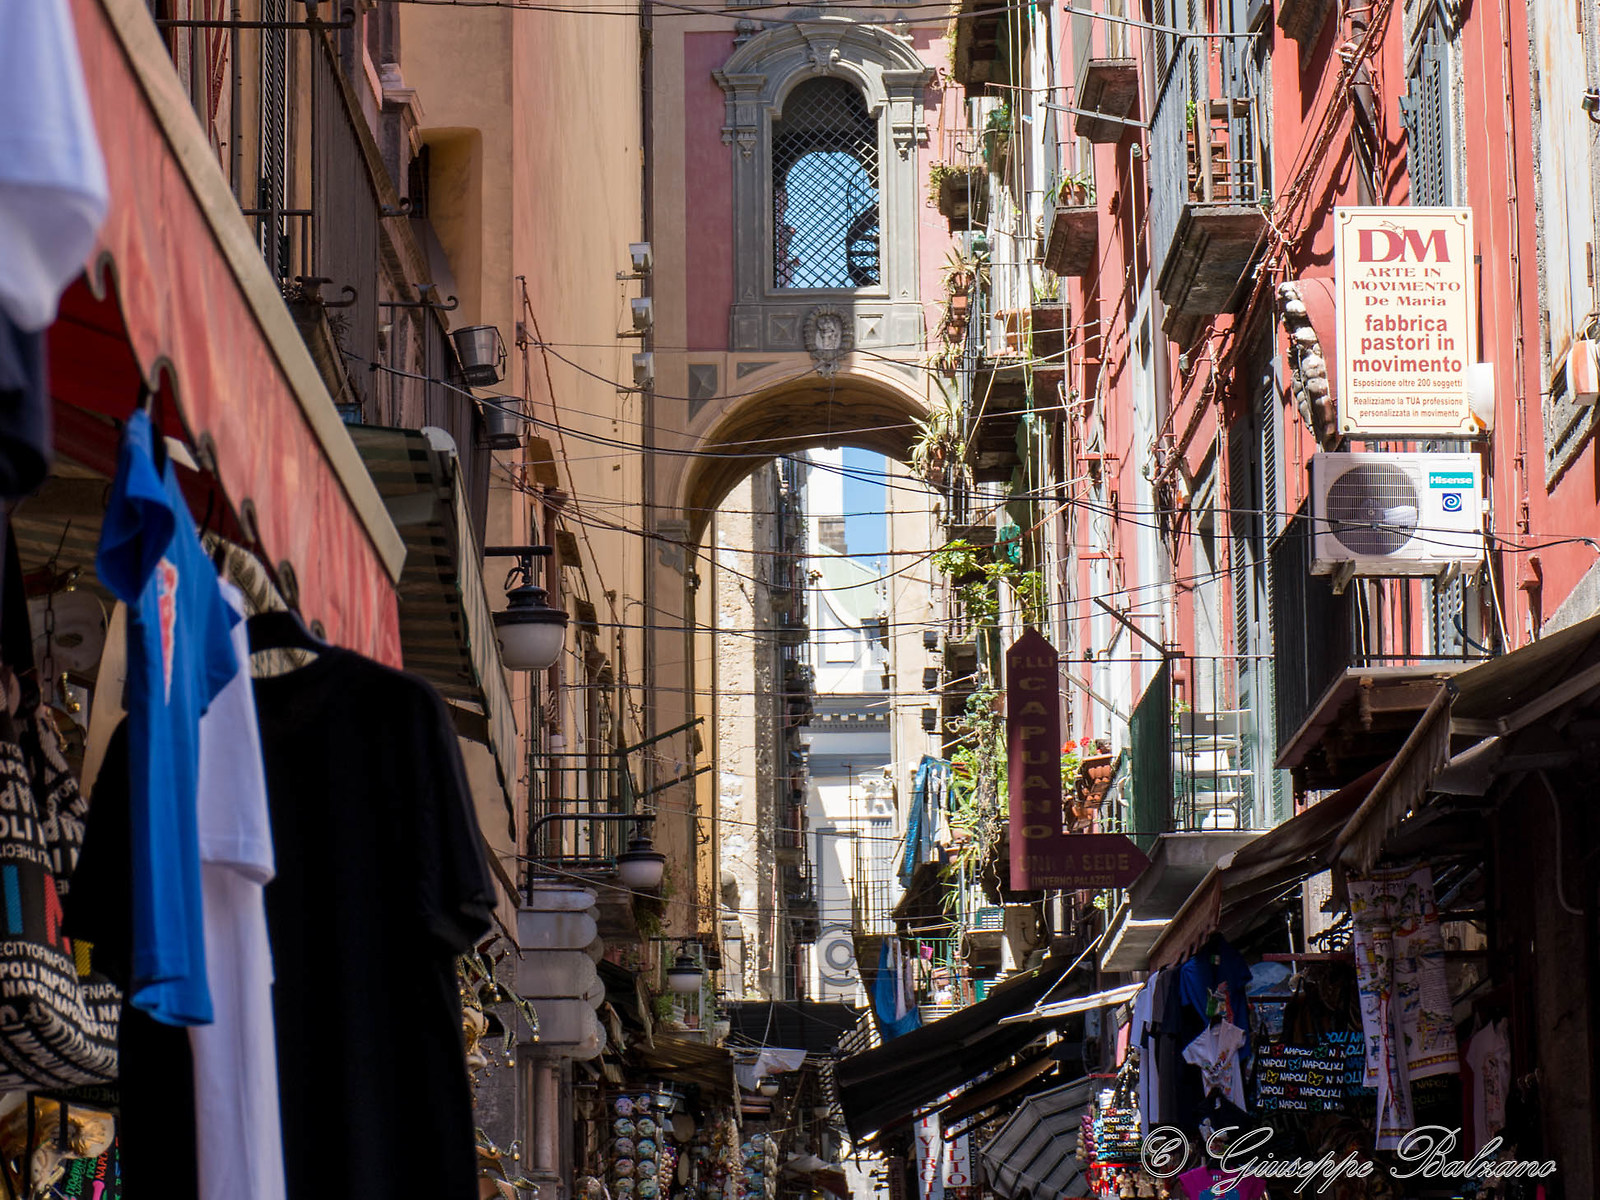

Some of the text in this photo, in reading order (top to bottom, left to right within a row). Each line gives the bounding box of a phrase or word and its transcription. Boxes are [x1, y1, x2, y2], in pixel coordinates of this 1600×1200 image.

[1358, 229, 1451, 263] DM
[1366, 267, 1441, 277] ARTE IN
[1352, 280, 1461, 291] MOVIMENTO
[1365, 296, 1446, 306] De Maria
[1365, 314, 1448, 332] fabbrica
[1361, 333, 1455, 354] pastori in
[1352, 355, 1462, 372] movimento
[1353, 378, 1463, 389] Esposizione oltre 200 soggetti
[1353, 396, 1463, 407] Realizziamo la TUA professione
[1359, 408, 1459, 419] personalizzata in movimento
[1430, 476, 1473, 484] Hisense
[1011, 655, 1054, 670] F.LLI
[1019, 677, 1053, 839] CAPUANO
[1082, 853, 1130, 872] SEDE
